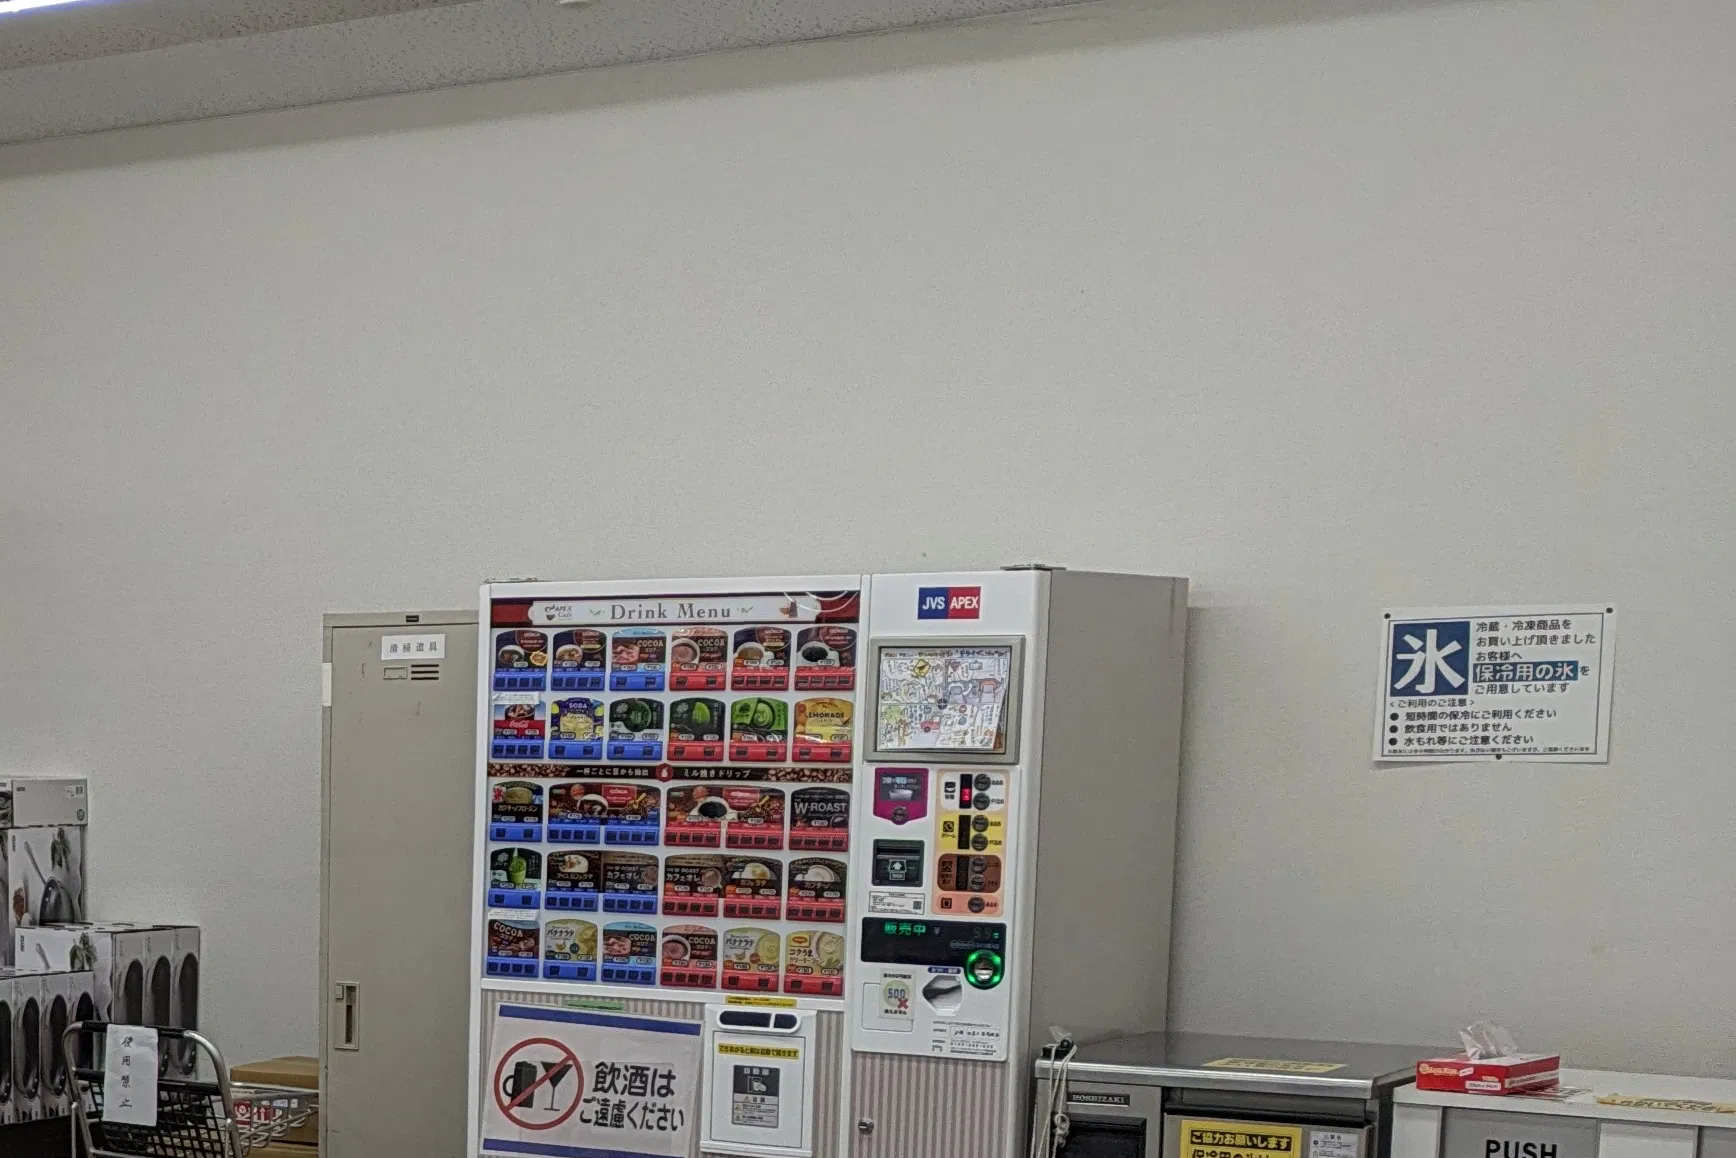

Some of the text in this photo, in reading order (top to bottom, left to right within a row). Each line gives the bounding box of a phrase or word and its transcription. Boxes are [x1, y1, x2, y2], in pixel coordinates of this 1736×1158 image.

[921, 595, 979, 610] JVS APEX
[609, 602, 731, 621] Drink Menu
[1475, 619, 1572, 633] 冷蔵・冷凍商品を
[1475, 632, 1597, 647] お買い上げ頂きました
[1393, 628, 1466, 694] 氷
[1475, 651, 1523, 662] お客様へ
[1474, 682, 1570, 696] ご用意しています
[883, 921, 927, 937] 販売中
[887, 988, 906, 999] 500
[592, 1061, 677, 1097] 飲酒は
[1071, 1093, 1126, 1105] HOSHIZAKI
[579, 1096, 685, 1132] ご遠慮ください
[1191, 1130, 1292, 1150] ご協力お願いします
